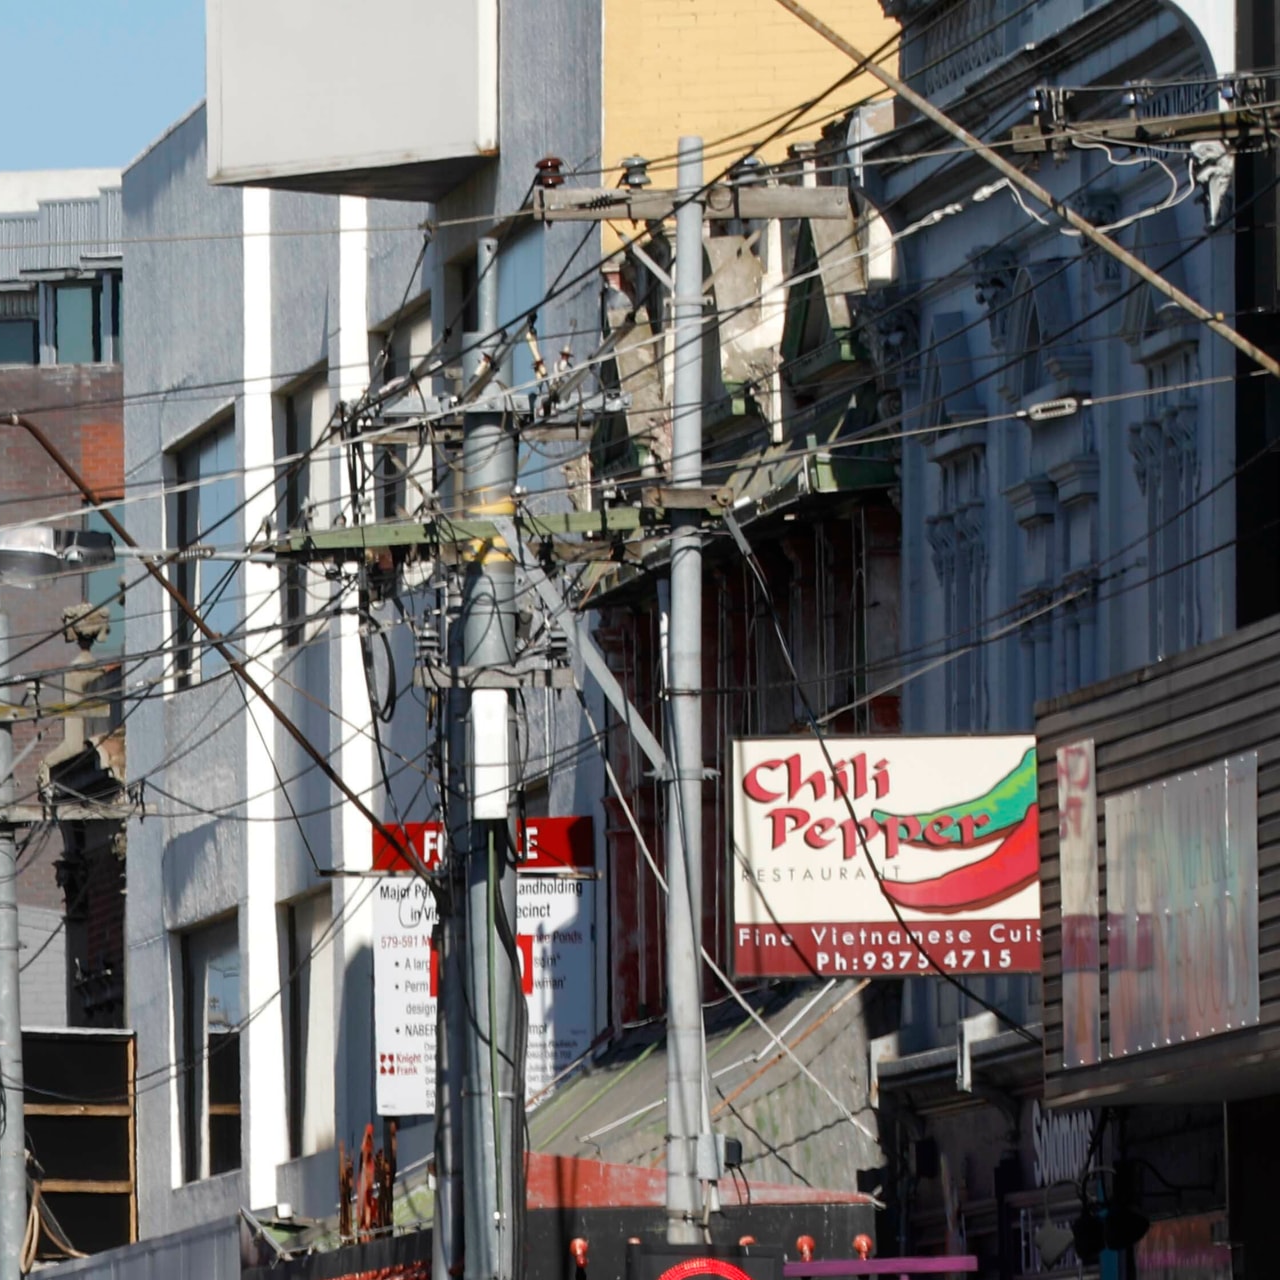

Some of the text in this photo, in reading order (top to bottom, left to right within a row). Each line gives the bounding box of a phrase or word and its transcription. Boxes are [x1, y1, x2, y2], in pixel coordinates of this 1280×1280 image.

[742, 751, 891, 804] Chili
[763, 807, 991, 861] Pepper
[740, 865, 902, 883] RESTAURANT
[380, 885, 411, 901] Major
[516, 903, 551, 919] ecinct
[739, 923, 1041, 948] Fine Vietnamese Cuis
[943, 949, 1012, 969] 4715
[406, 1001, 437, 1018] design
[405, 1023, 437, 1037] NABER
[396, 1053, 422, 1065] Knight
[396, 1065, 418, 1076] Frank
